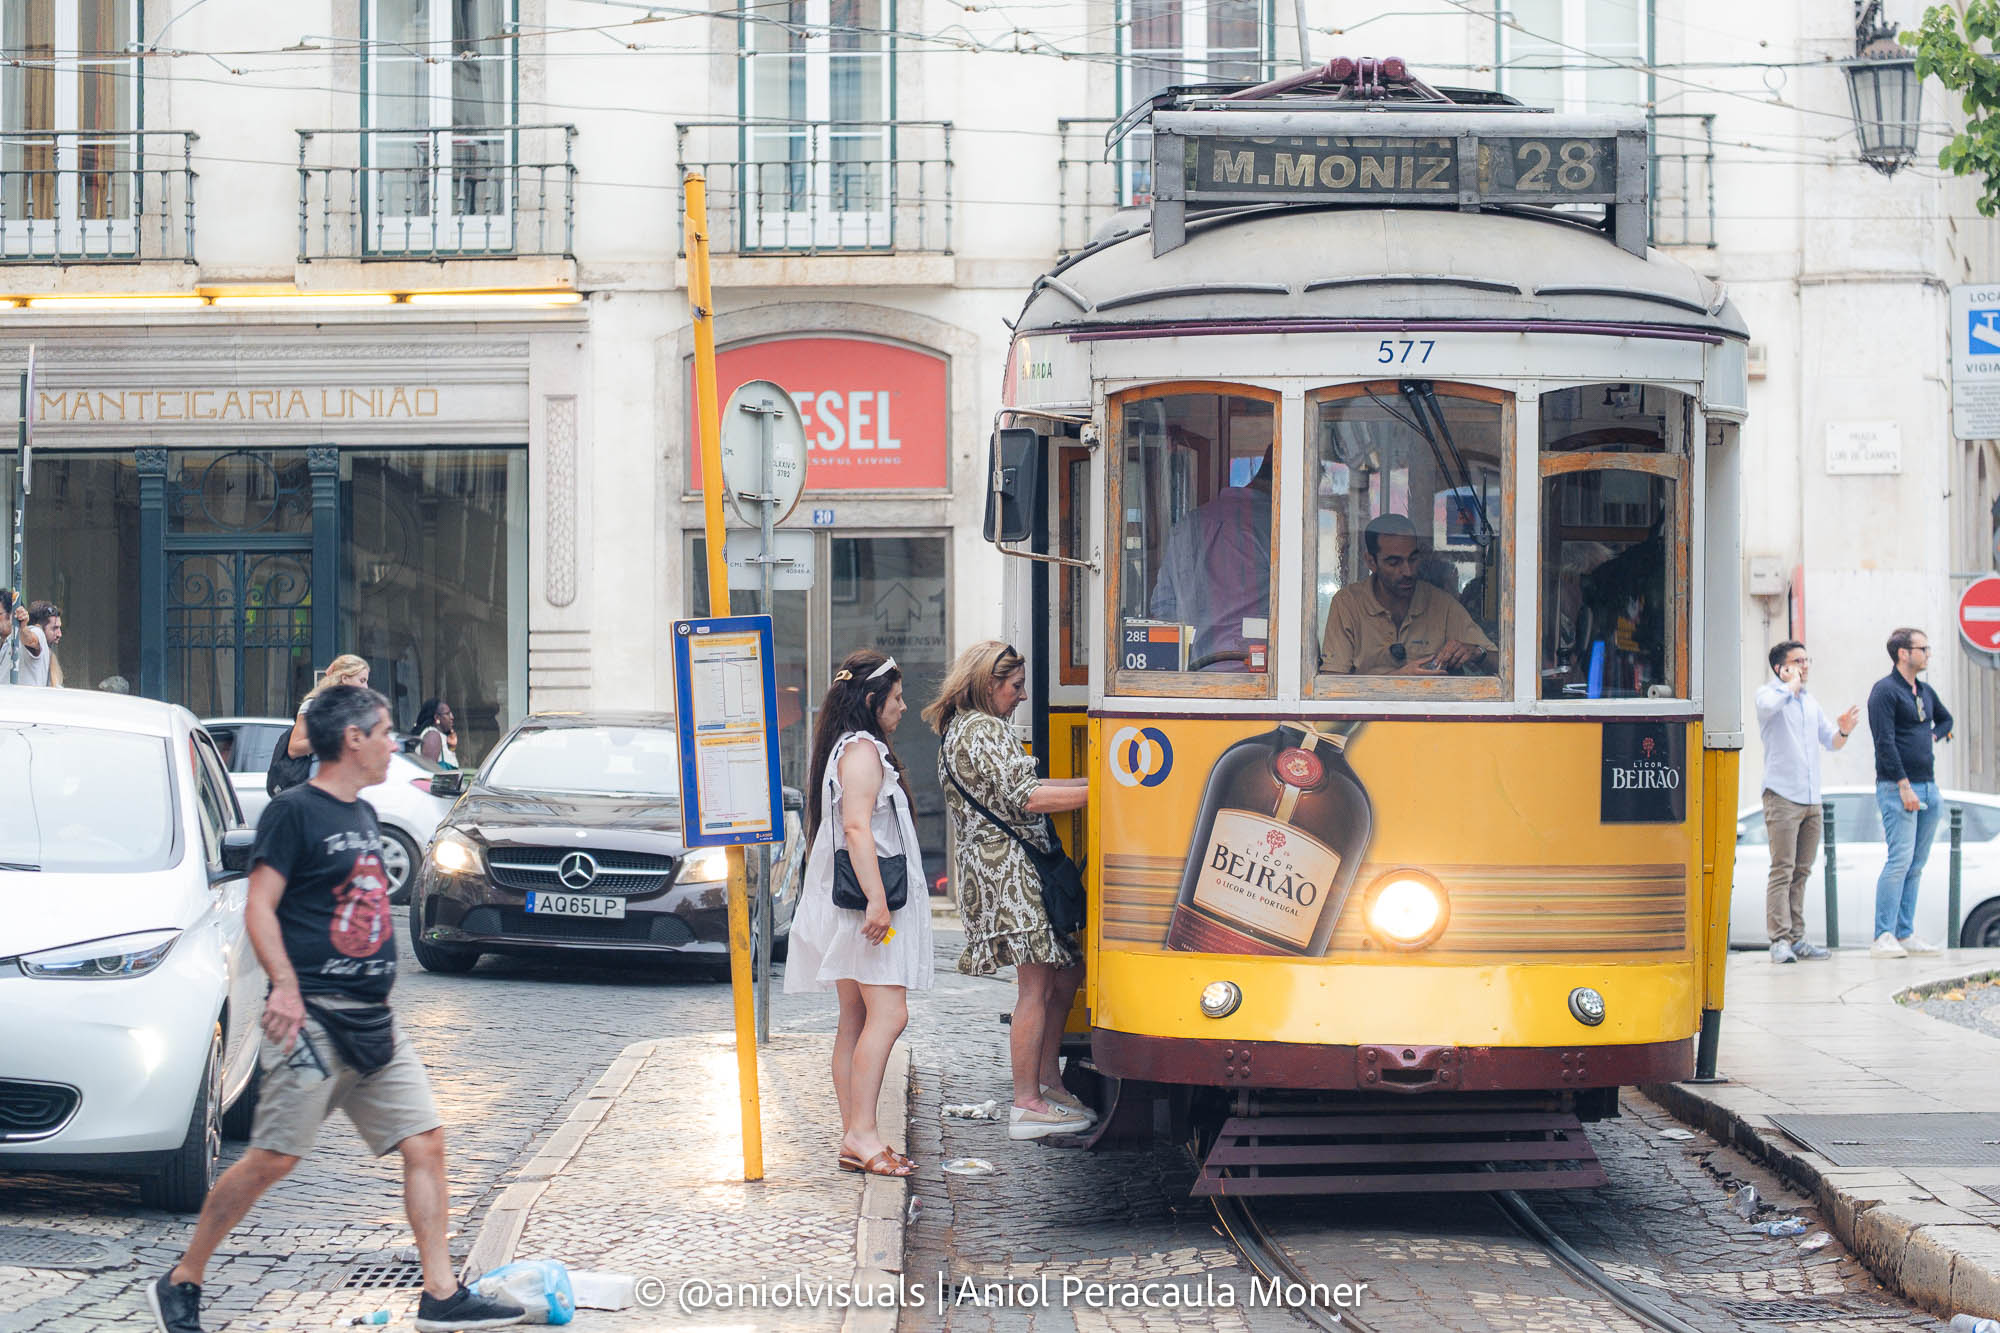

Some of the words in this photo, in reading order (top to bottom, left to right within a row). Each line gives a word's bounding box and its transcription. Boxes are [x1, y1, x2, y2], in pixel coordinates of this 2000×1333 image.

[1212, 150, 1450, 189] M.MONIZ
[1516, 140, 1596, 190] 28
[1378, 340, 1435, 363] 577
[39, 389, 311, 420] MANTEIGARIA
[321, 386, 439, 418] UNIÃO
[789, 390, 901, 450] ESEL
[857, 456, 901, 465] LIVING
[816, 511, 831, 524] 30
[876, 635, 946, 646] WOMENSW
[1126, 631, 1147, 642] 28E
[1126, 653, 1147, 669] 08
[1611, 766, 1680, 789] BEIRÃO
[1246, 848, 1293, 870] LICOR
[1210, 843, 1317, 906] BEIRÃO
[540, 895, 617, 915] AQ65LP
[1223, 880, 1245, 895] LICOR
[1246, 890, 1257, 899] DE
[1259, 896, 1299, 916] PORTUGAL
